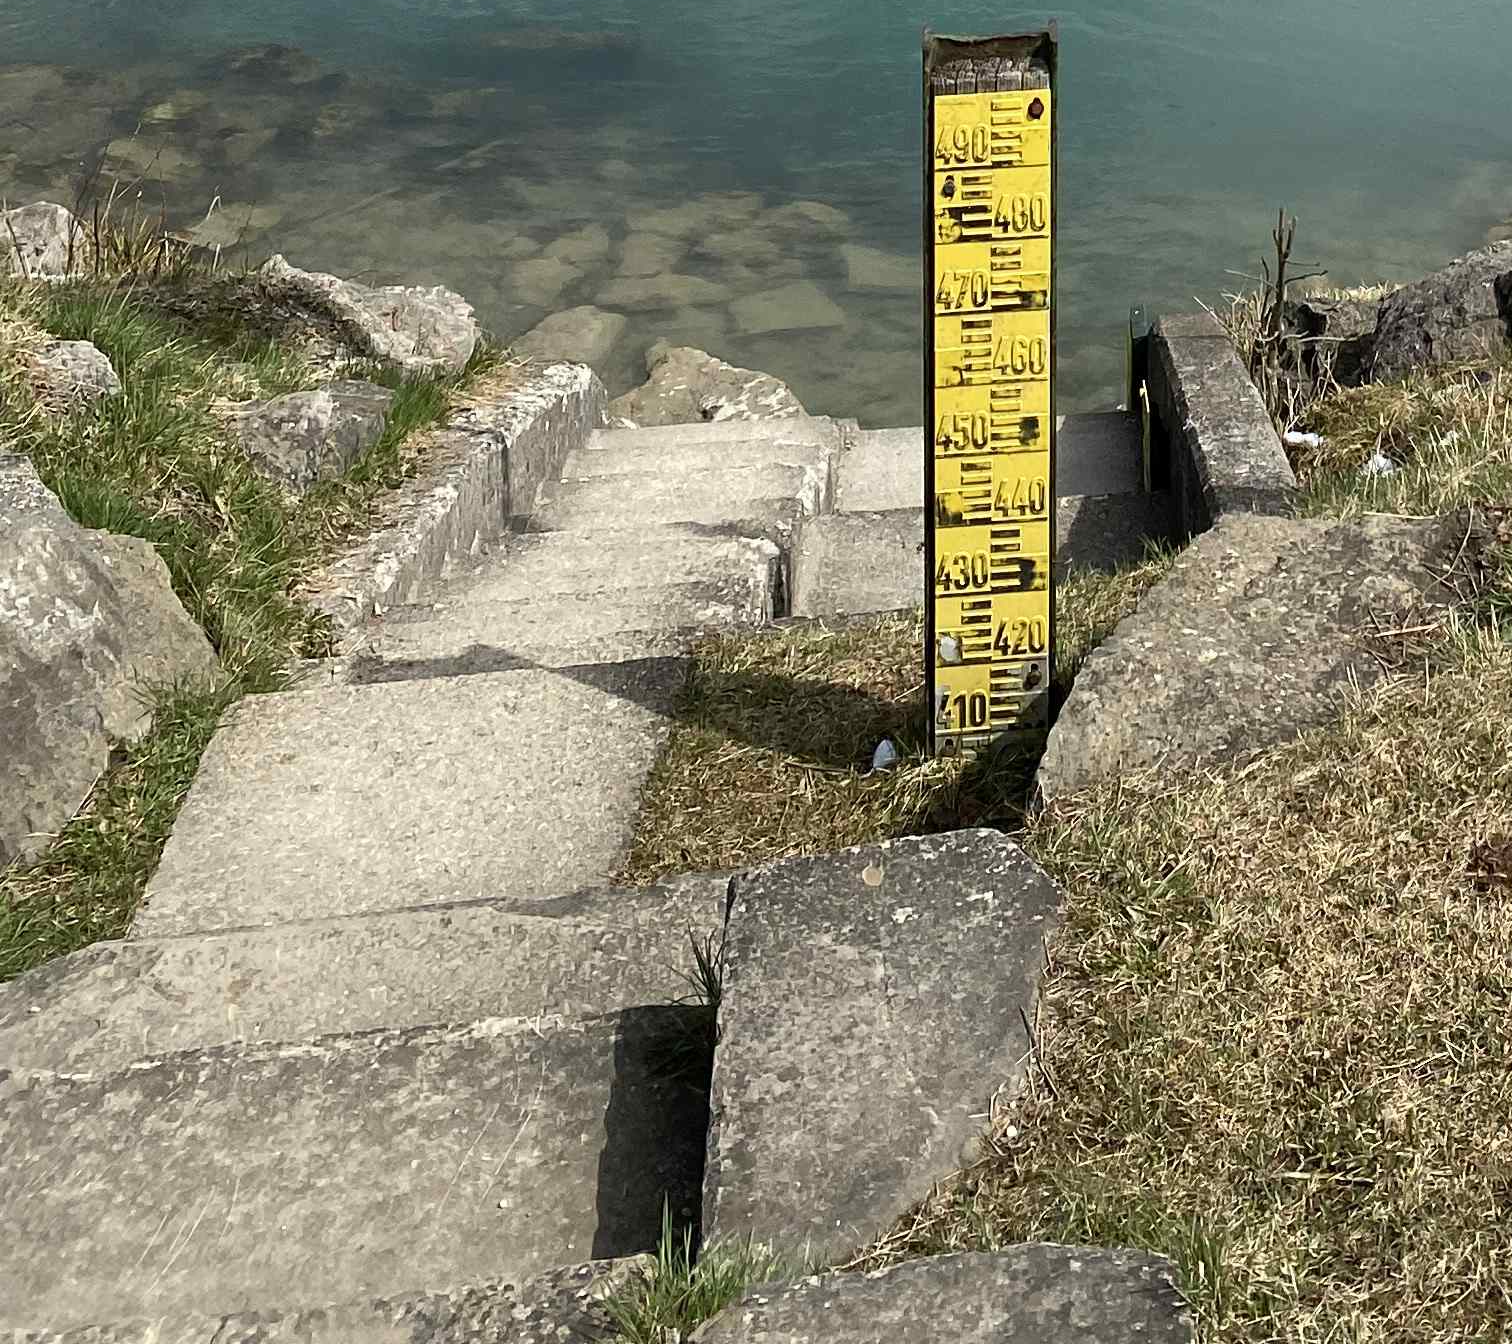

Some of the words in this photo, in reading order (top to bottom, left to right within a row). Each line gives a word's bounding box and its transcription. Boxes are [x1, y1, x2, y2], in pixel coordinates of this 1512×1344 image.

[935, 125, 990, 164] 490
[935, 271, 989, 310] 470
[992, 336, 1046, 376] 460
[935, 413, 989, 452] 450
[993, 477, 1046, 517] 440
[935, 551, 989, 592] 430
[993, 616, 1046, 657] 420
[936, 690, 988, 729] 410
